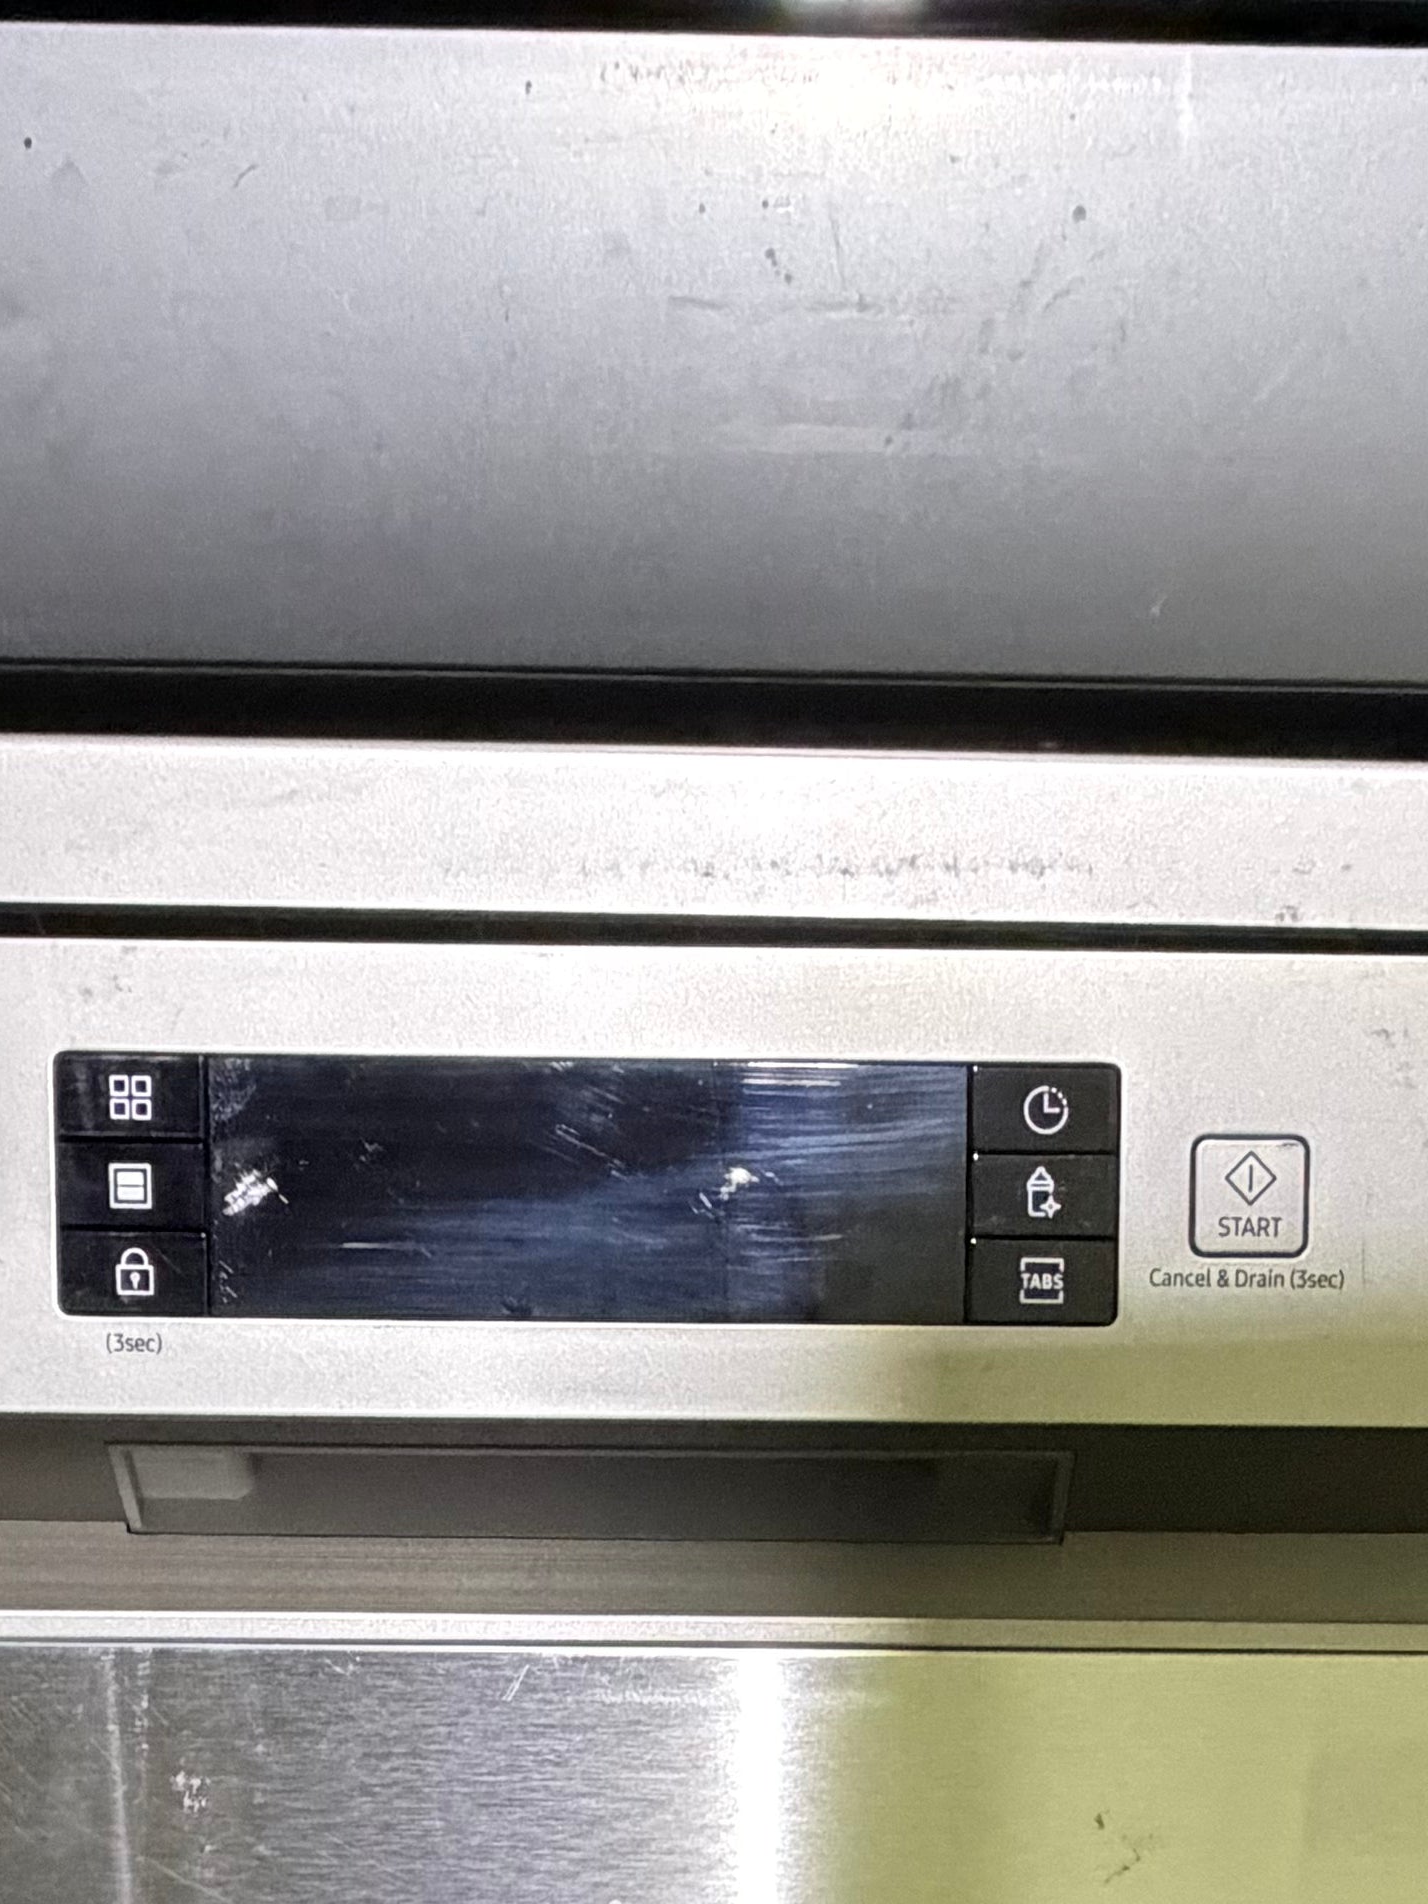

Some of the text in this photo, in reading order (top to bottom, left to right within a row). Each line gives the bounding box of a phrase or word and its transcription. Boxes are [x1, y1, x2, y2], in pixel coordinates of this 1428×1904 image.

[1218, 1216, 1282, 1237] START
[1020, 1273, 1064, 1289] TABS
[1149, 1267, 1345, 1290] Cancel & Drain (3sec)
[105, 1333, 163, 1355] (3sec)
